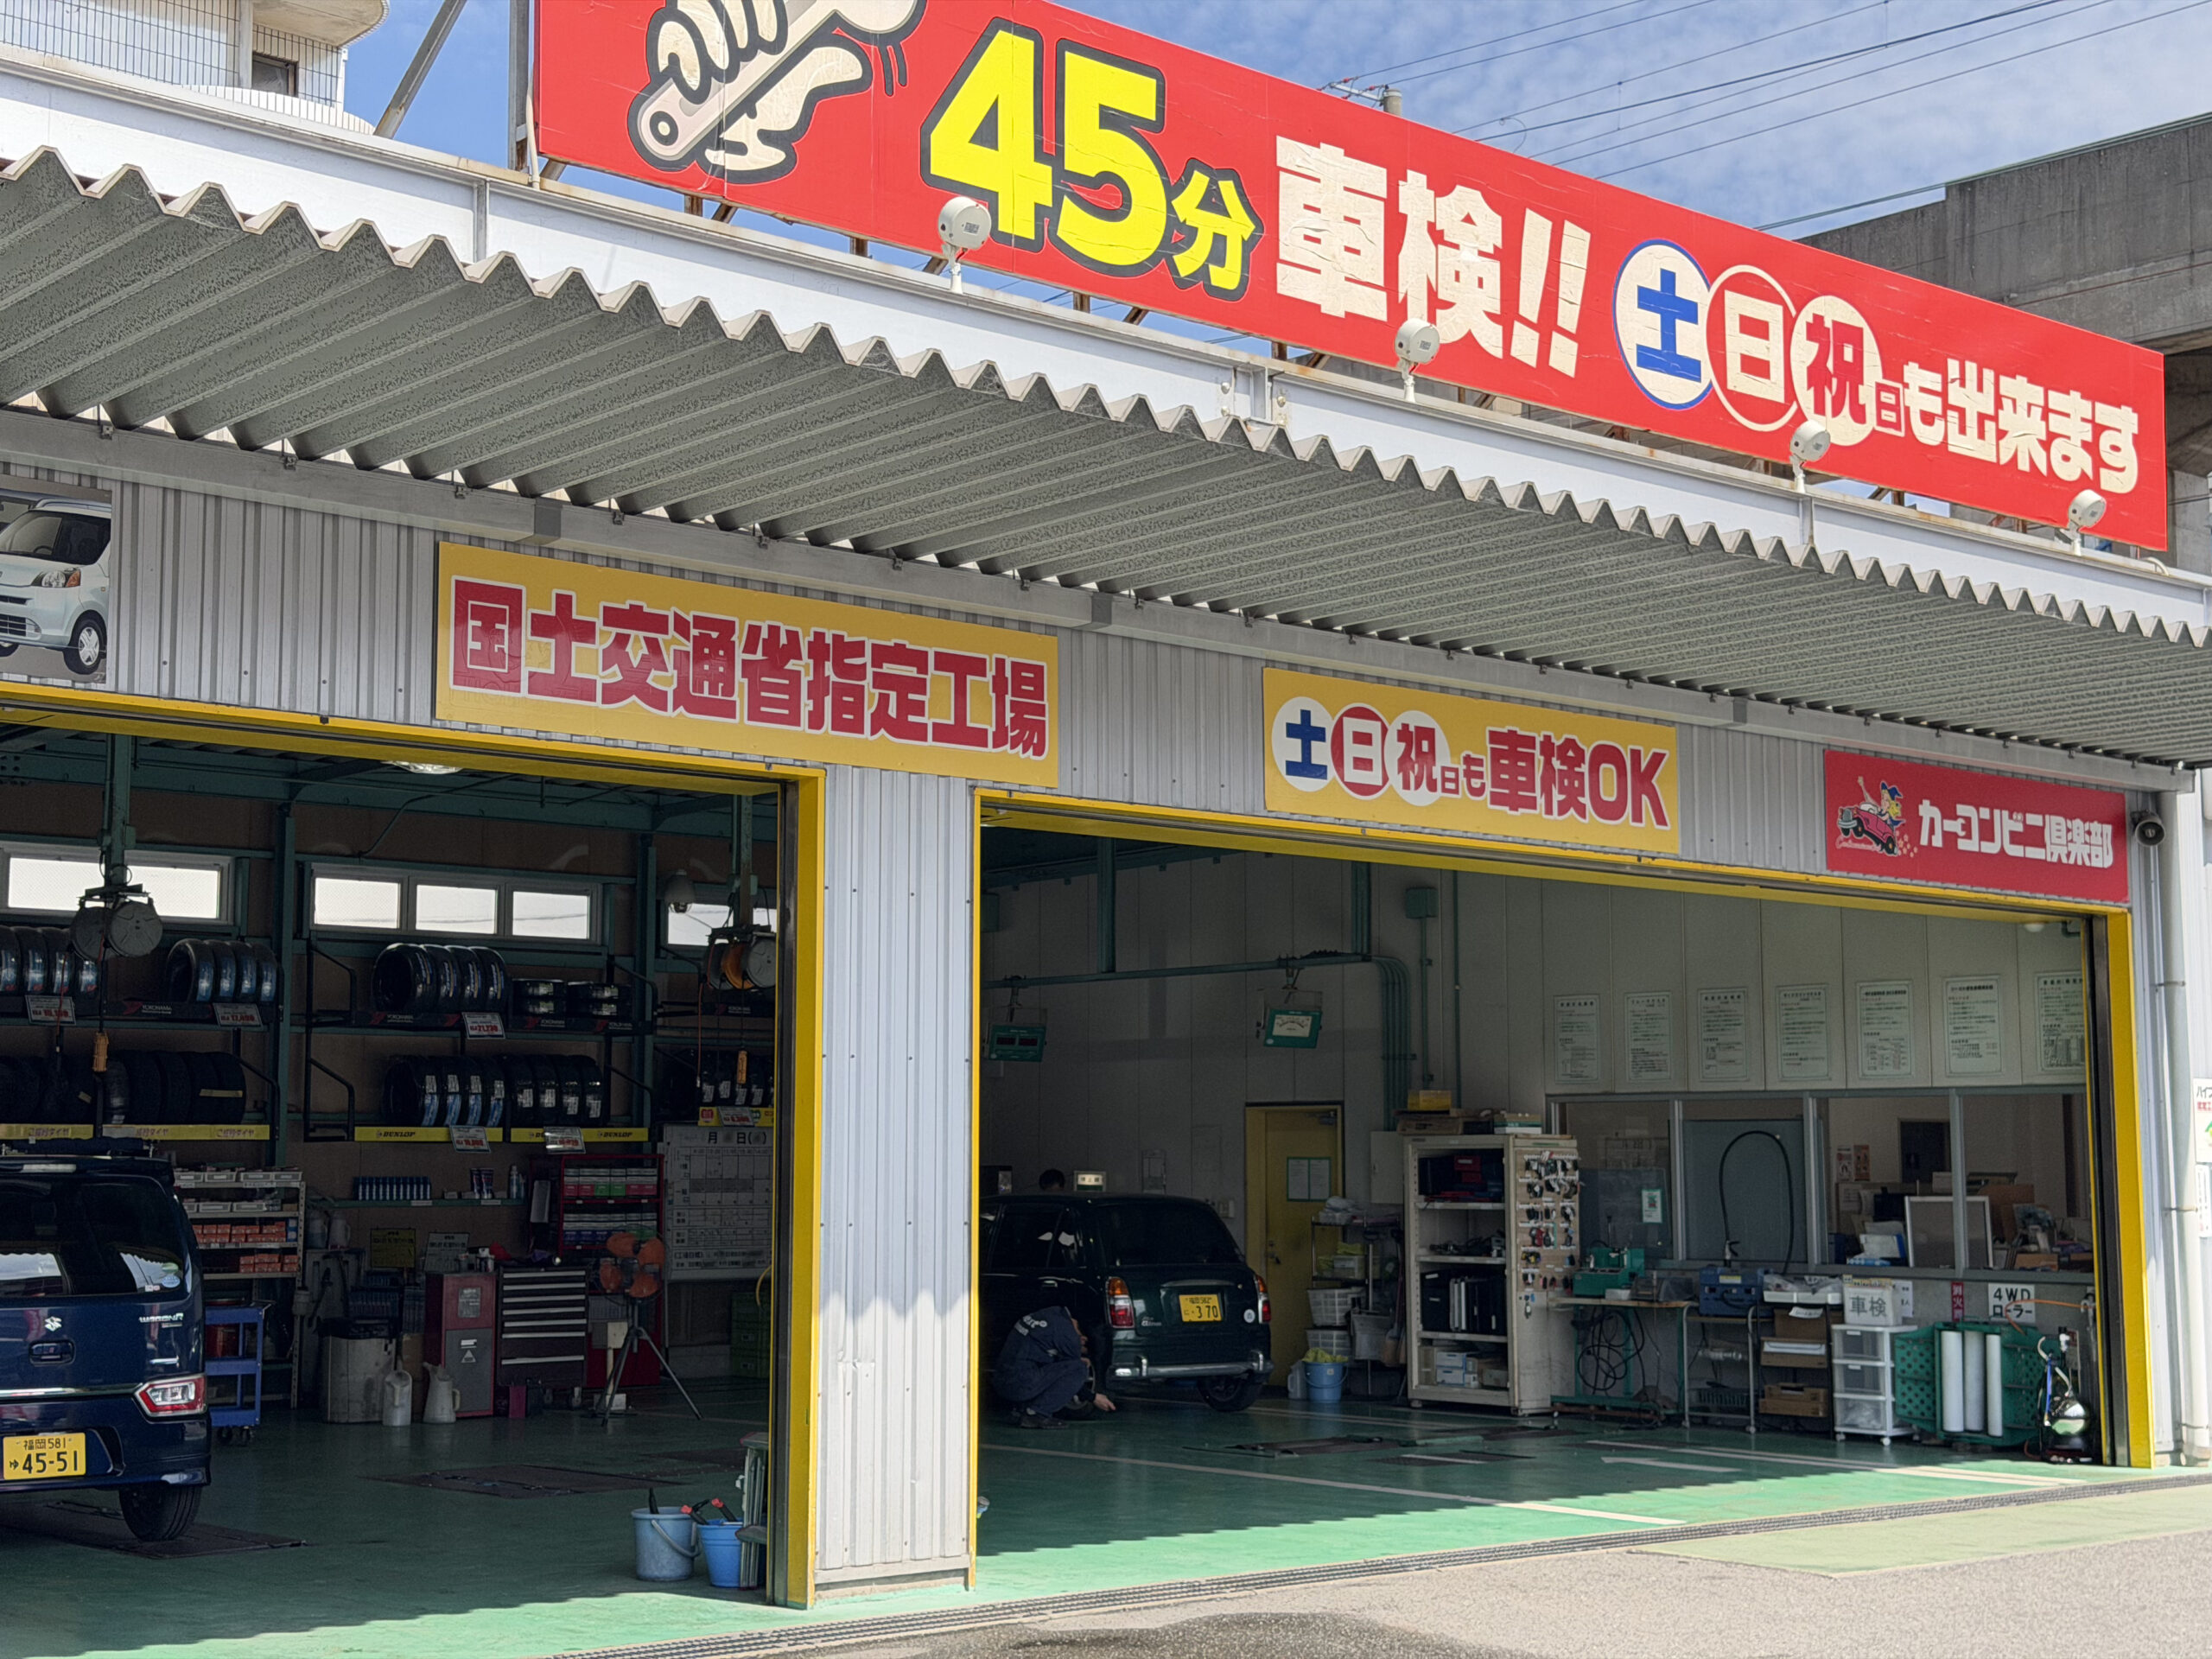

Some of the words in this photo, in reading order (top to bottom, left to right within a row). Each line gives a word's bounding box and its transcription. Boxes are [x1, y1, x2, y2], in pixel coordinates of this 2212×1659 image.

[451, 575, 1049, 760] 国土交通省指定工場
[1918, 798, 2114, 869] カーコンビニ倶楽部
[1993, 1287, 2031, 1301] 4WD
[1849, 1295, 1887, 1319] 車検
[22, 1450, 78, 1474] 45-51
